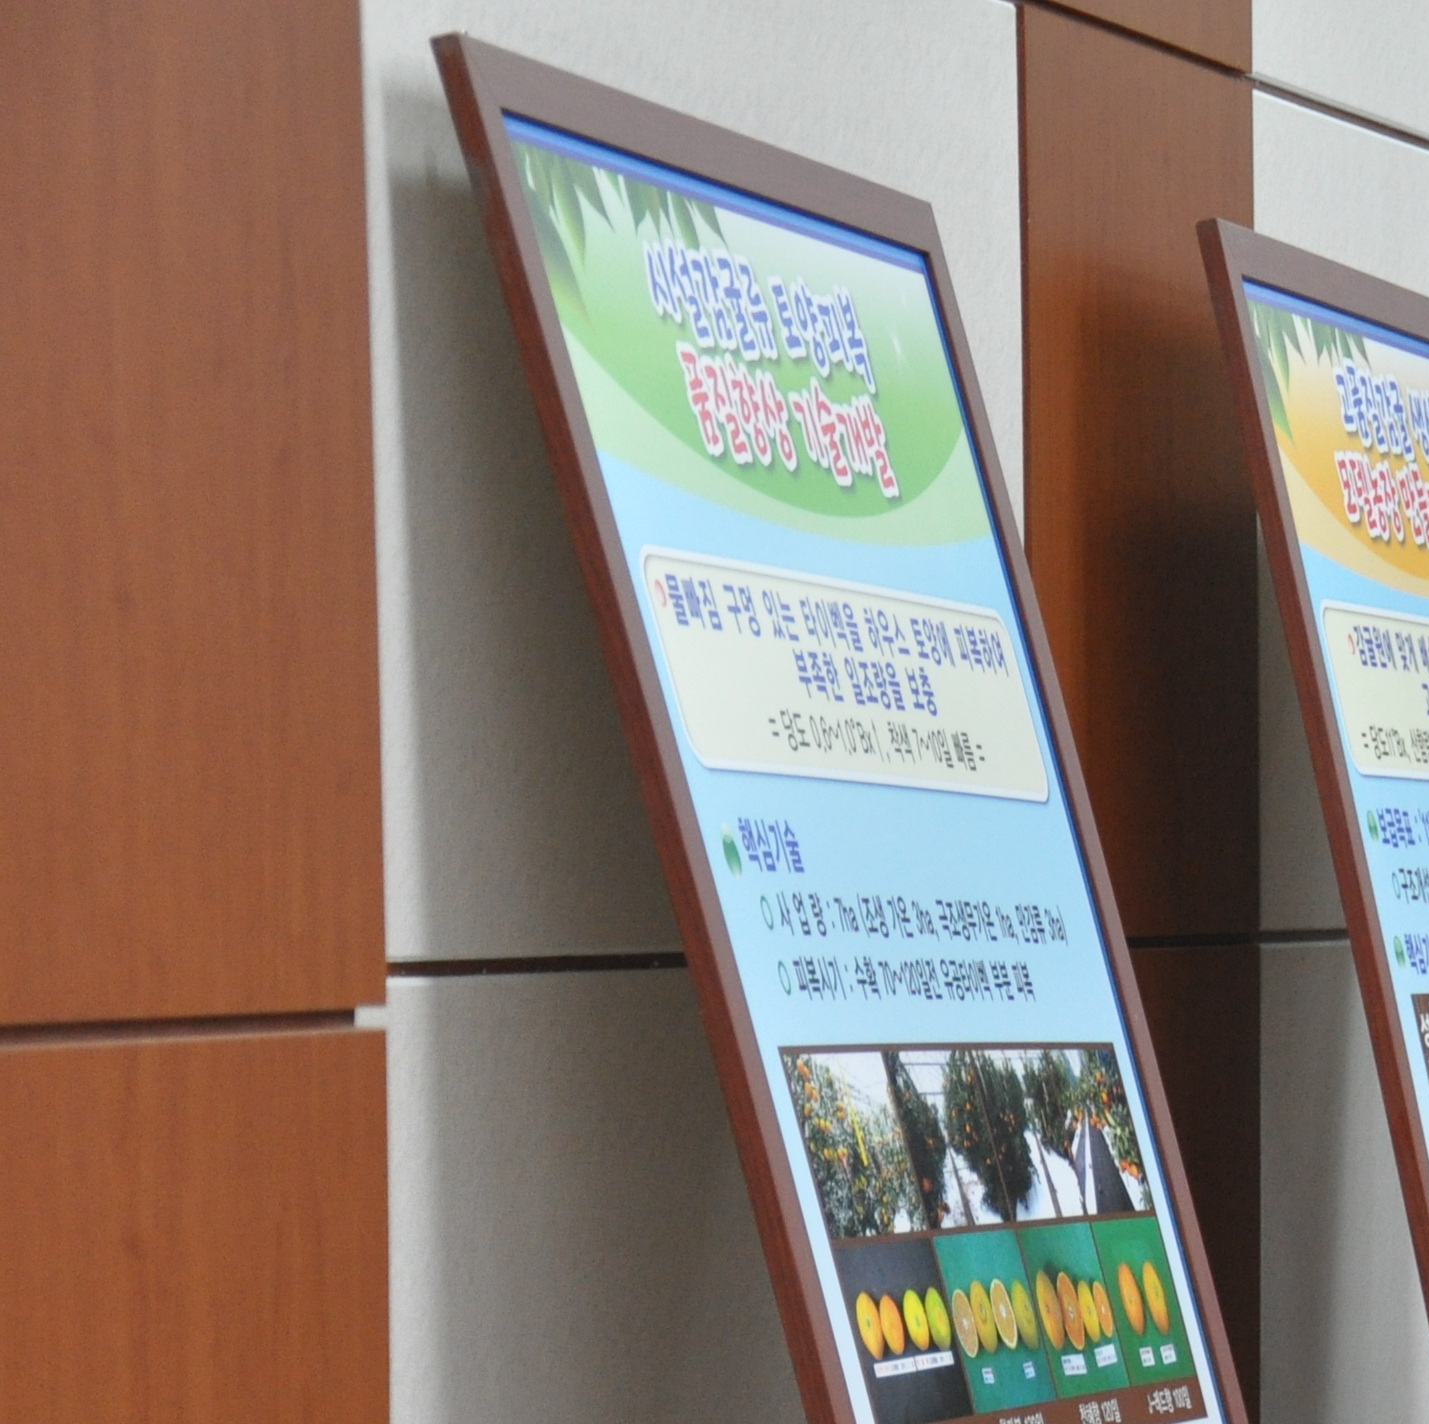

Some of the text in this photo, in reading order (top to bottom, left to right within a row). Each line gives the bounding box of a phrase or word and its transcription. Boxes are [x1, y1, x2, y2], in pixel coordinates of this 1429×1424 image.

[644, 239, 875, 394] 시설감귤류 토양피복
[676, 340, 899, 499] 품질향상 기술개발
[1333, 357, 1414, 461] 고품질감귤
[1335, 449, 1405, 542] 모델농장
[663, 572, 1010, 678] 물빠짐 구멍 있는 타이벡을 하우스 토양에 피복하여
[791, 649, 939, 717] 부족한 일조량을 보충
[778, 706, 814, 757] 당도
[884, 719, 918, 768] 착색
[949, 727, 978, 774] 빠름
[736, 817, 806, 874] 핵심기술
[1375, 807, 1416, 848] 보급목표
[885, 896, 915, 939] 가온
[790, 955, 846, 999] 피복시기
[850, 956, 882, 1000] 수확
[988, 959, 1015, 1001] 부분
[1009, 960, 1036, 1001] 피복
